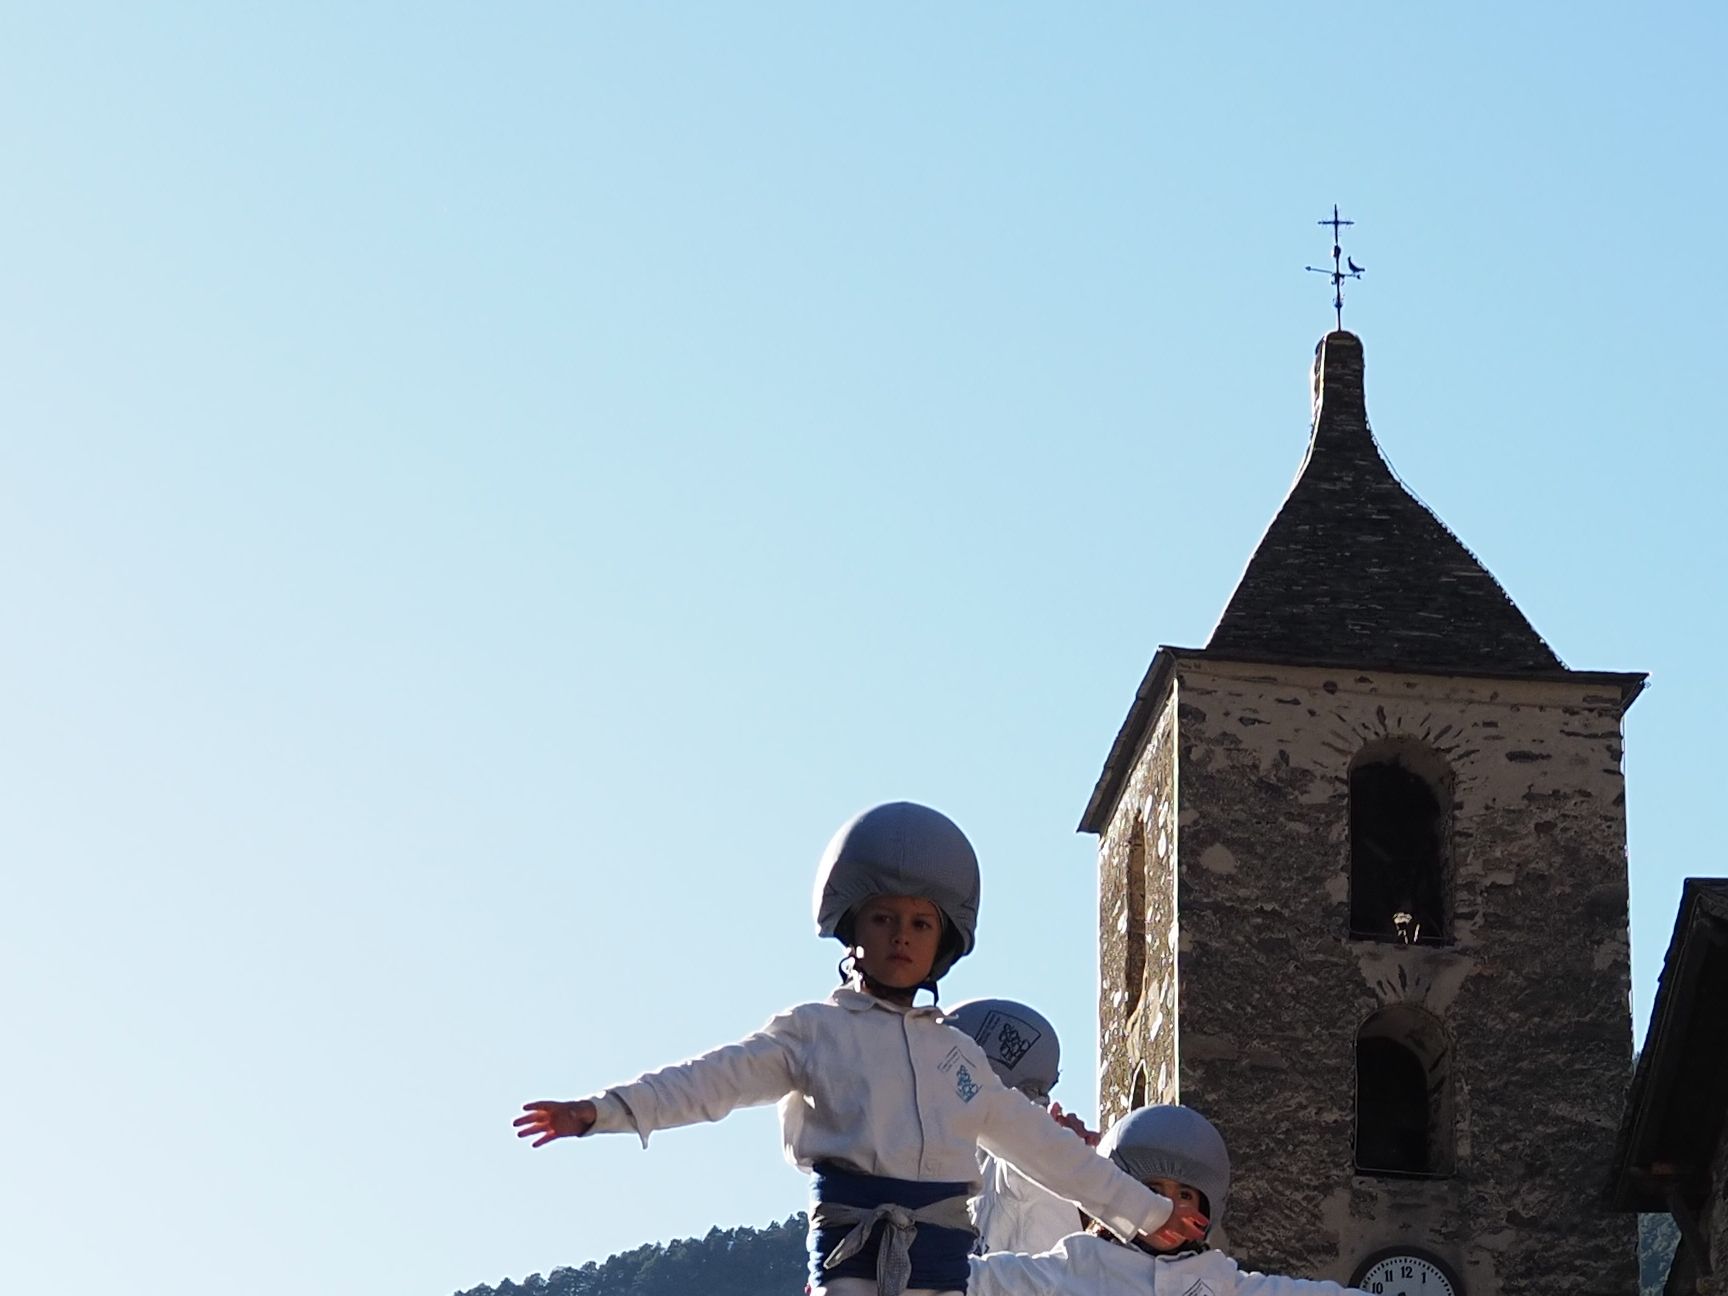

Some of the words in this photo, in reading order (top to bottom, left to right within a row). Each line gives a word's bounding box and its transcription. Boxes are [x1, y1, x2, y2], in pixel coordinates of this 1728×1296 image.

[1385, 1269, 1393, 1282] 11
[1401, 1266, 1413, 1279] 12
[1421, 1272, 1426, 1284] 1
[1372, 1282, 1383, 1294] 10
